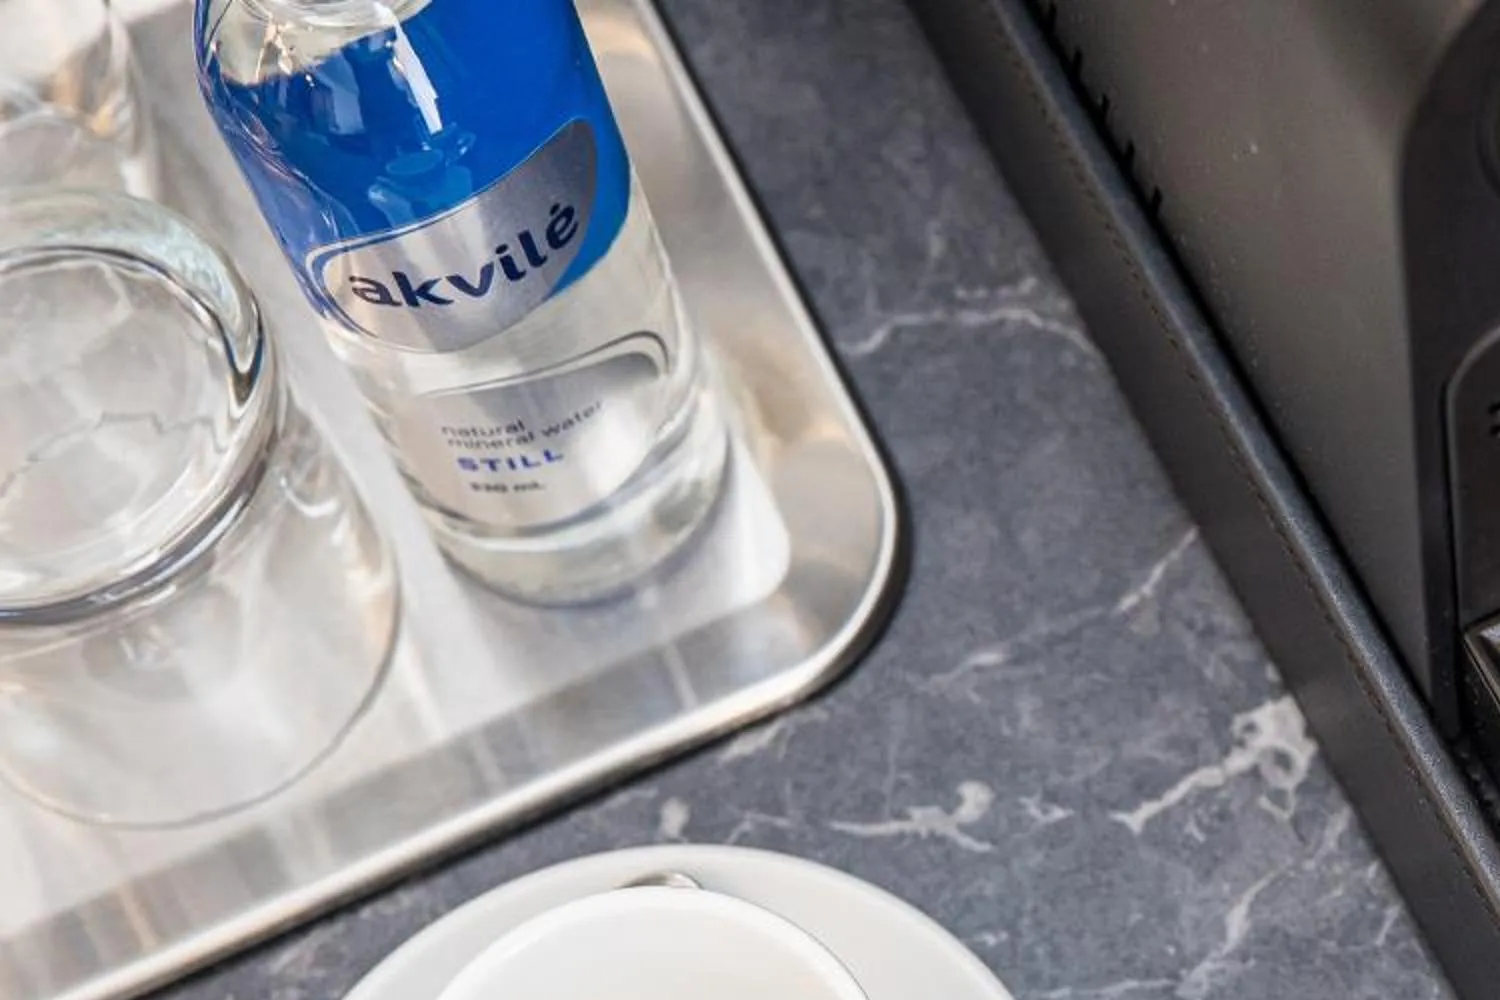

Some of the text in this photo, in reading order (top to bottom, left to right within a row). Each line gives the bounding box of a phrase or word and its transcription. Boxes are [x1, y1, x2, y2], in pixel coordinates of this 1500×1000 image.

[441, 419, 526, 437] natural
[447, 431, 536, 448] mineral
[457, 449, 564, 473] STILL
